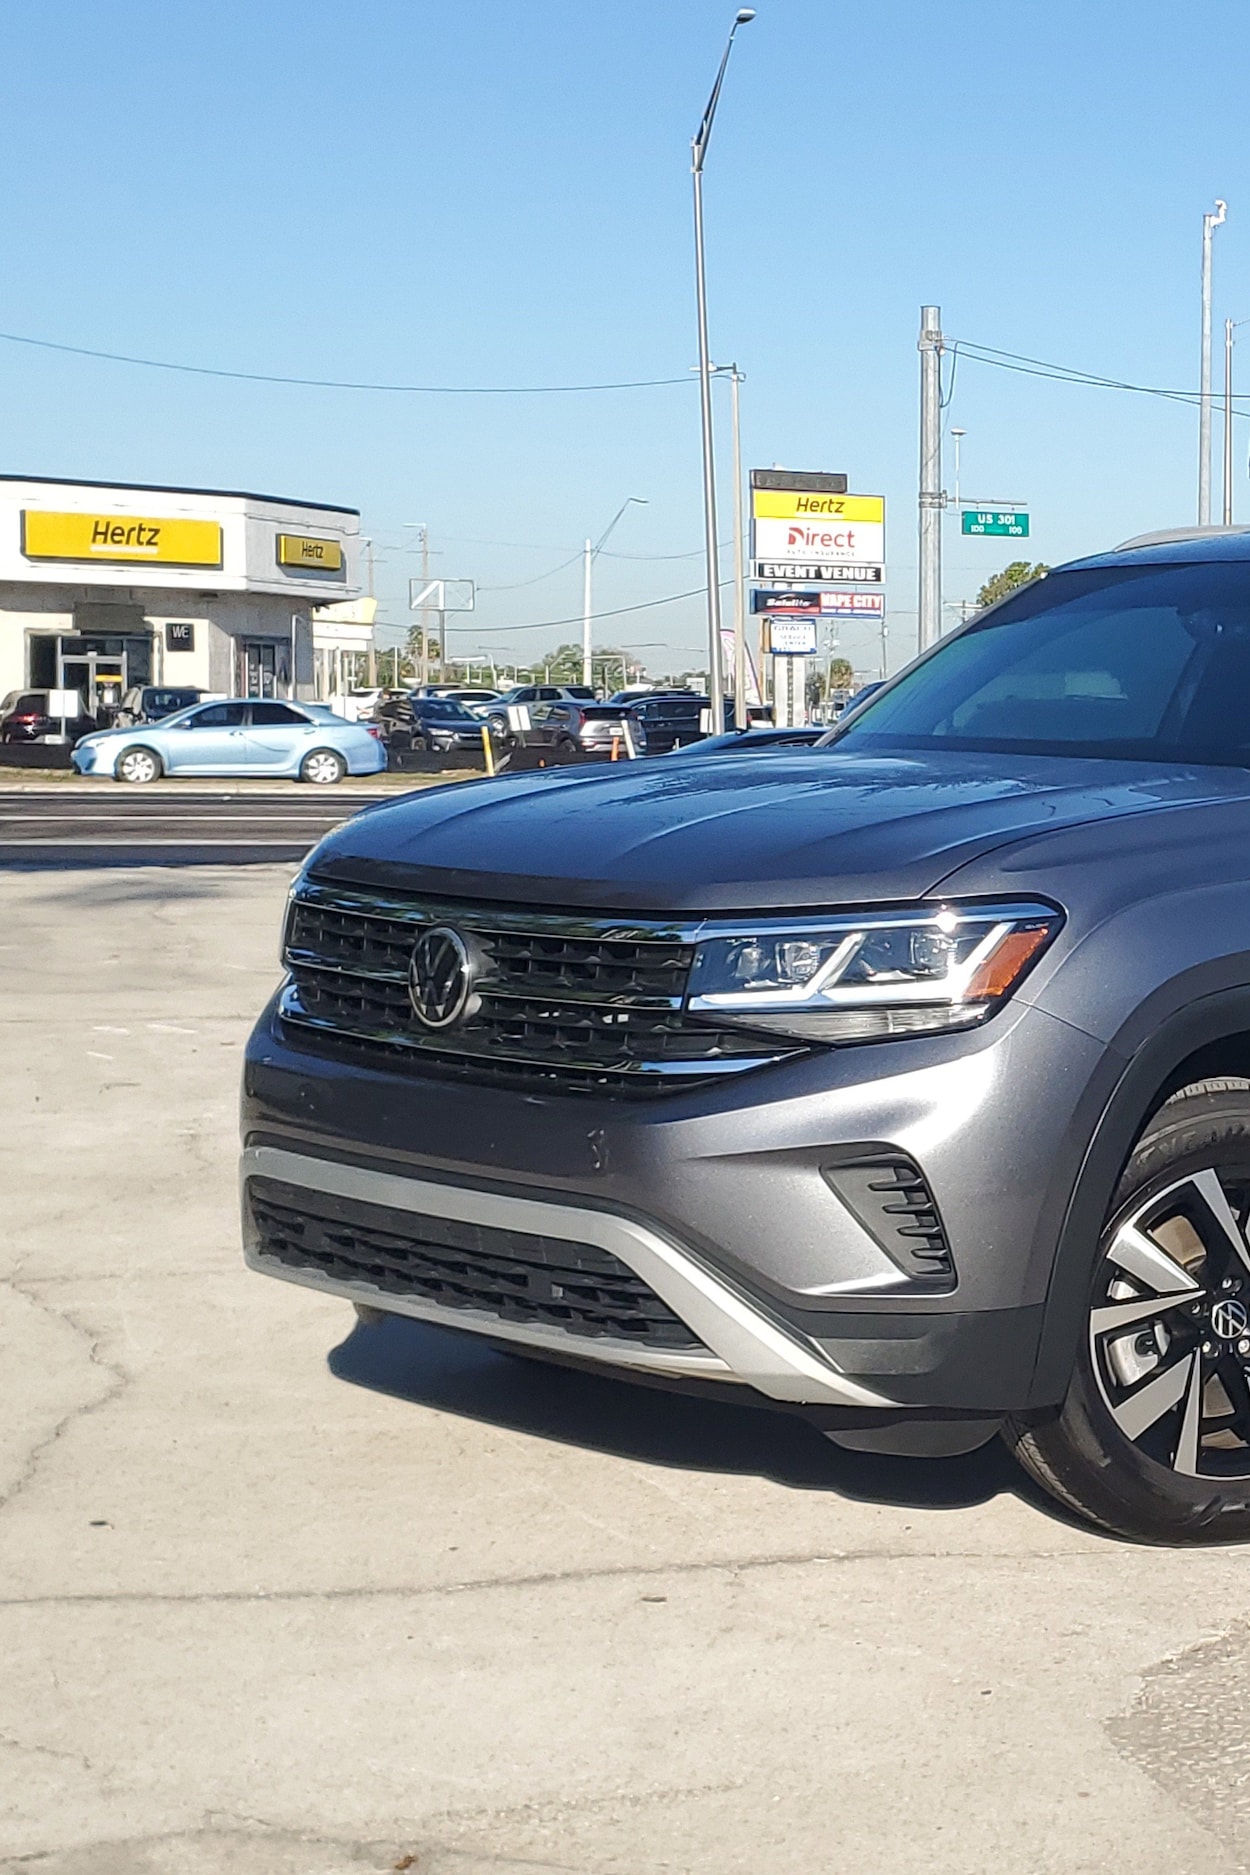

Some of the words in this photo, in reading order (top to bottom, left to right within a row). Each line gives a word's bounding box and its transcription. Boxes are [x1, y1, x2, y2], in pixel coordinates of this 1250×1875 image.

[796, 497, 846, 513] Hertz
[977, 513, 993, 524] US
[997, 514, 1016, 525] 301
[91, 520, 161, 546] Hertz
[788, 527, 855, 548] Direct
[302, 541, 324, 559] Hertz
[763, 564, 819, 579] EVENT
[820, 566, 877, 581] VENUE
[821, 593, 853, 608] VAPE
[853, 594, 881, 609] CITY
